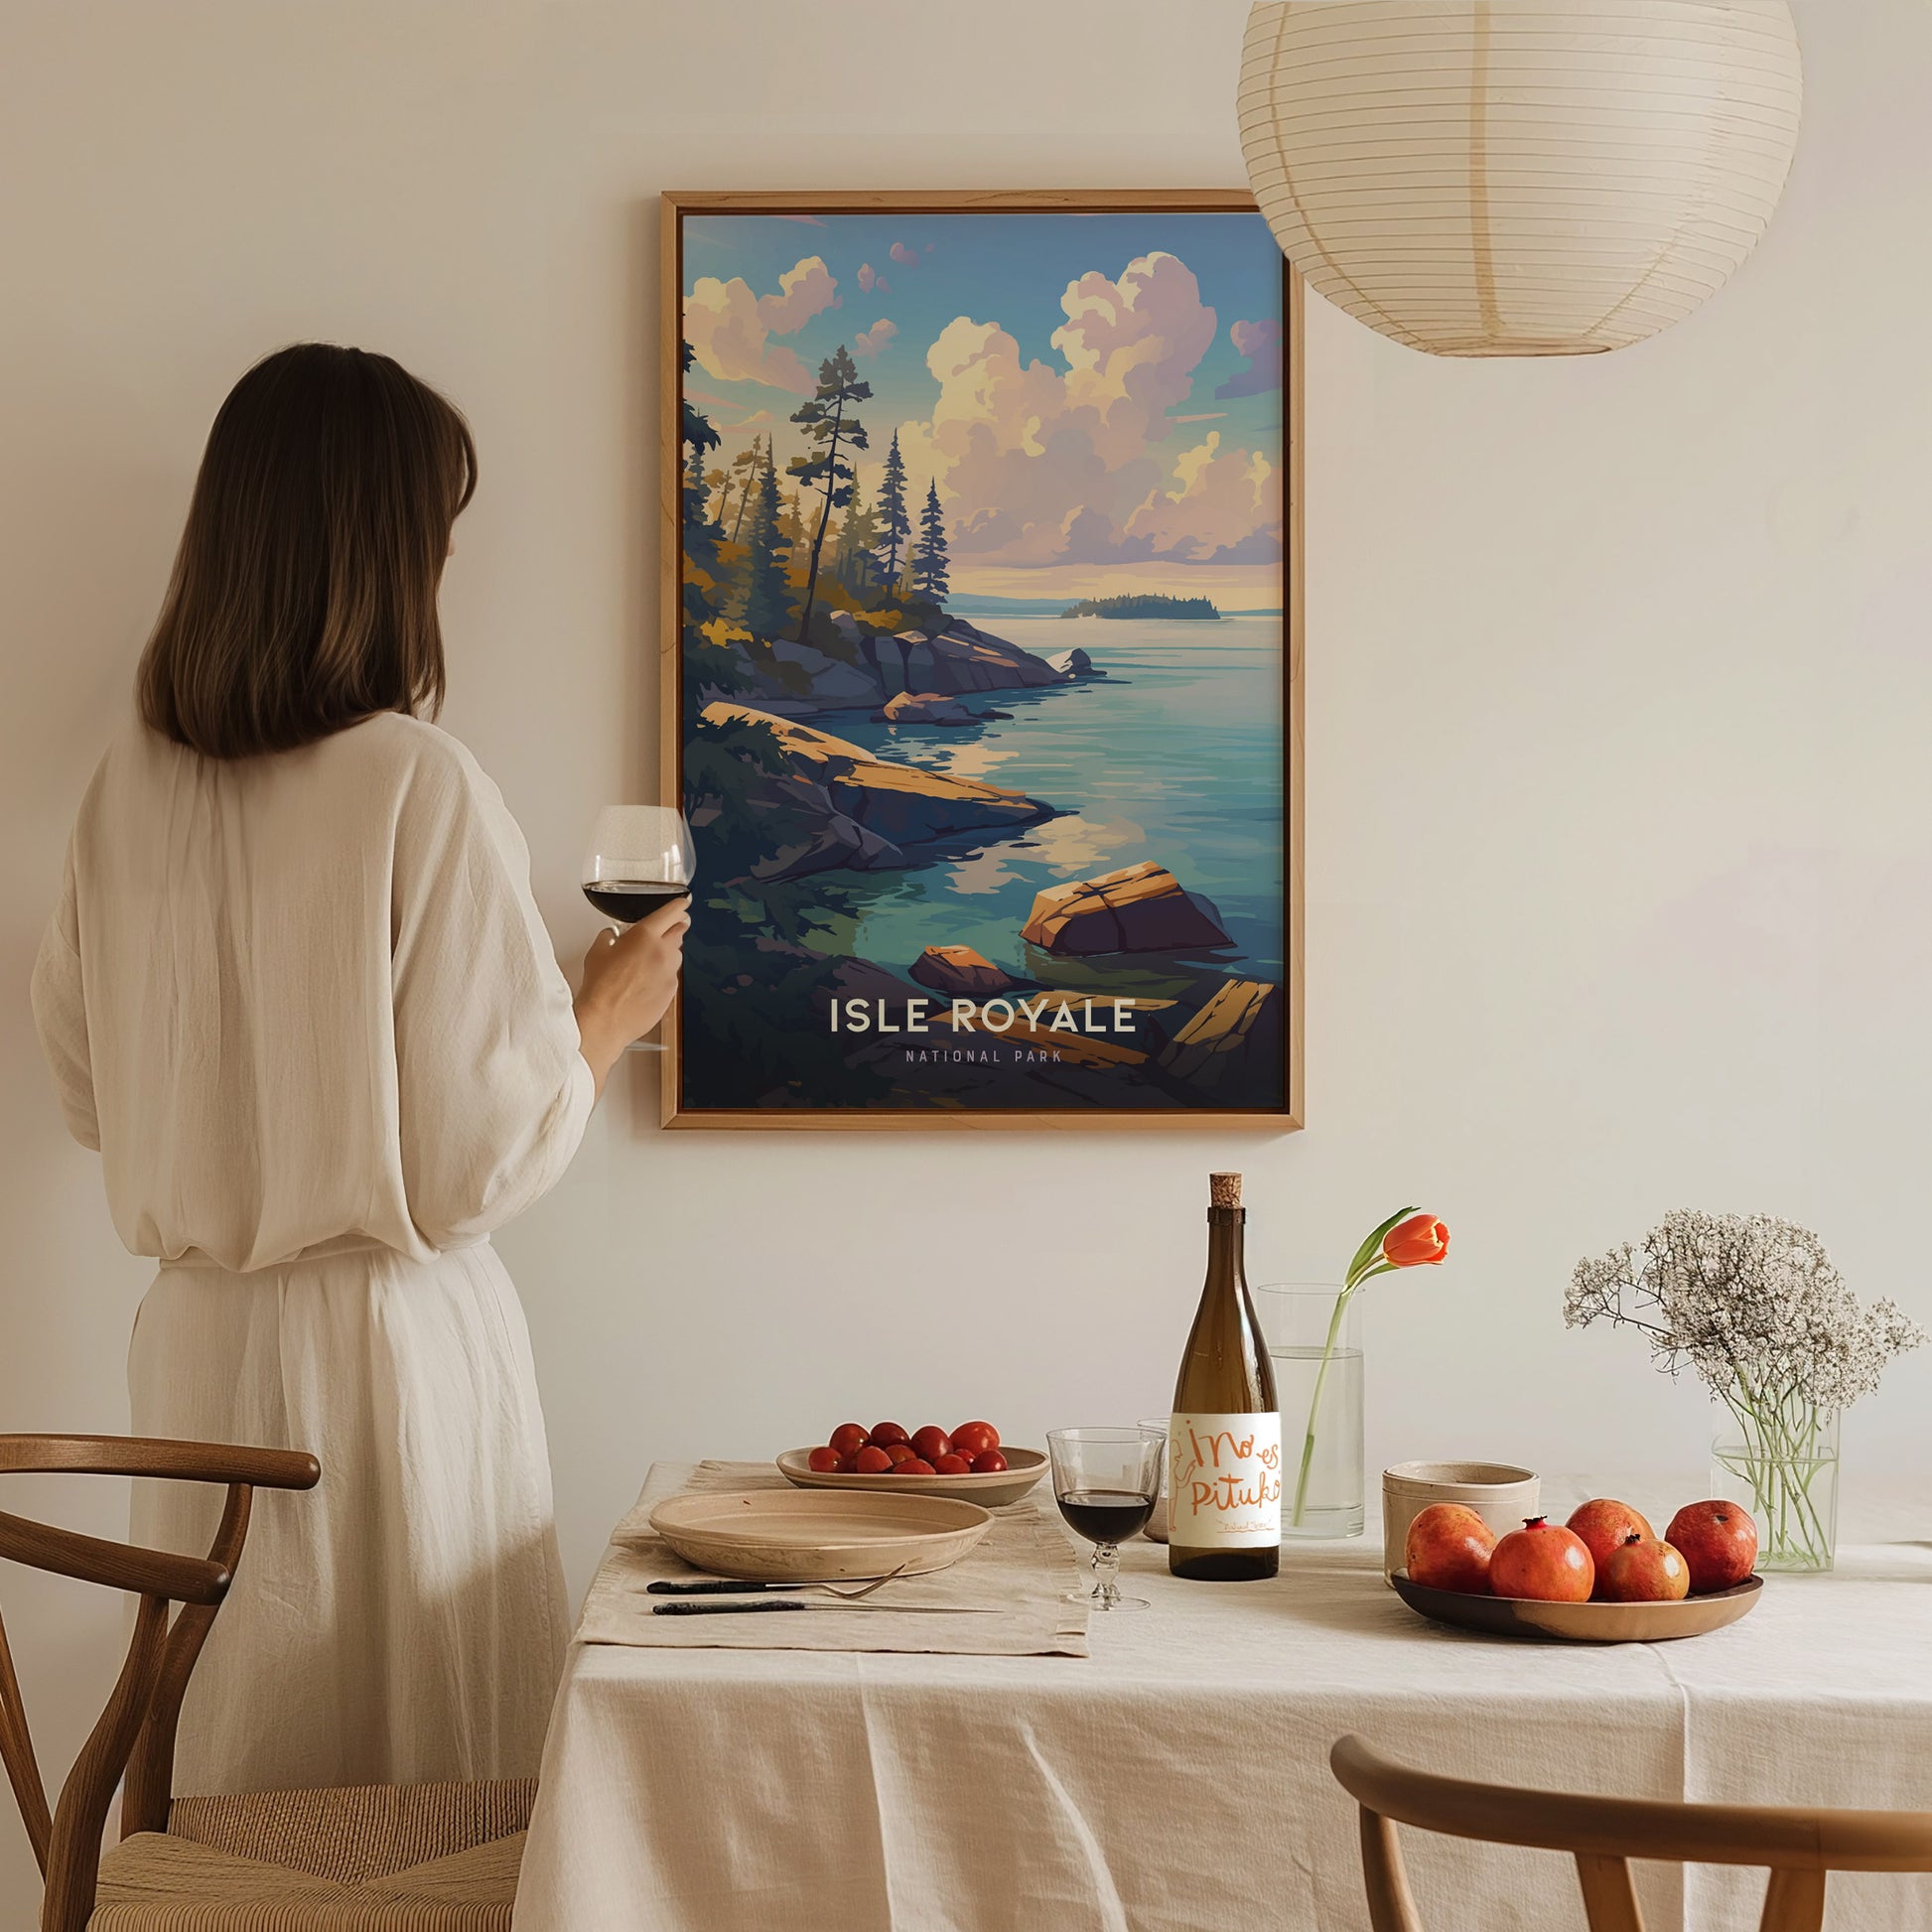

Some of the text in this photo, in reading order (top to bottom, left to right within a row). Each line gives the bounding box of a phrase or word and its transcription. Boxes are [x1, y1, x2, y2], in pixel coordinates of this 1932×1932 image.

[831, 999, 1136, 1033] ISLE ROYALE
[905, 1049, 1062, 1062] NATIONAL PARK
[1256, 1444, 1279, 1469] es
